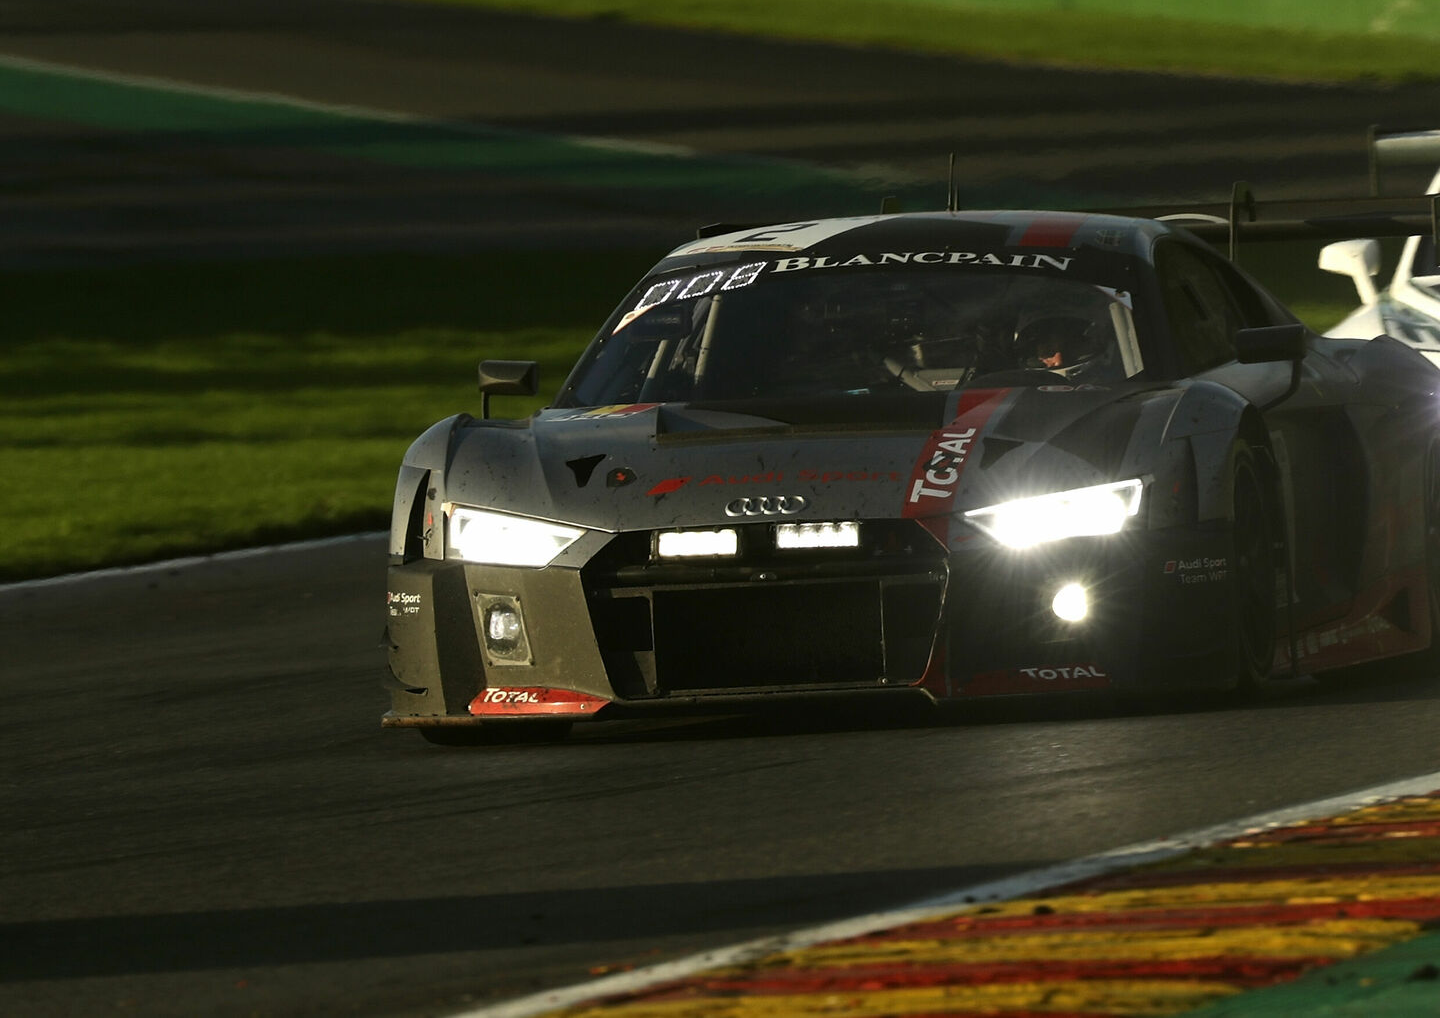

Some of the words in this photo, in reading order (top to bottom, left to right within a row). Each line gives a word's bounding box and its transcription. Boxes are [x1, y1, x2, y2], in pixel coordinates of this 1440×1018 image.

[735, 222, 819, 243] 2
[769, 251, 1075, 273] BLANCPAIN
[699, 469, 785, 486] Audi
[799, 468, 905, 484] Sport
[401, 592, 421, 605] Sport
[1020, 666, 1106, 680] TOTAL
[483, 687, 539, 703] TOTAL
